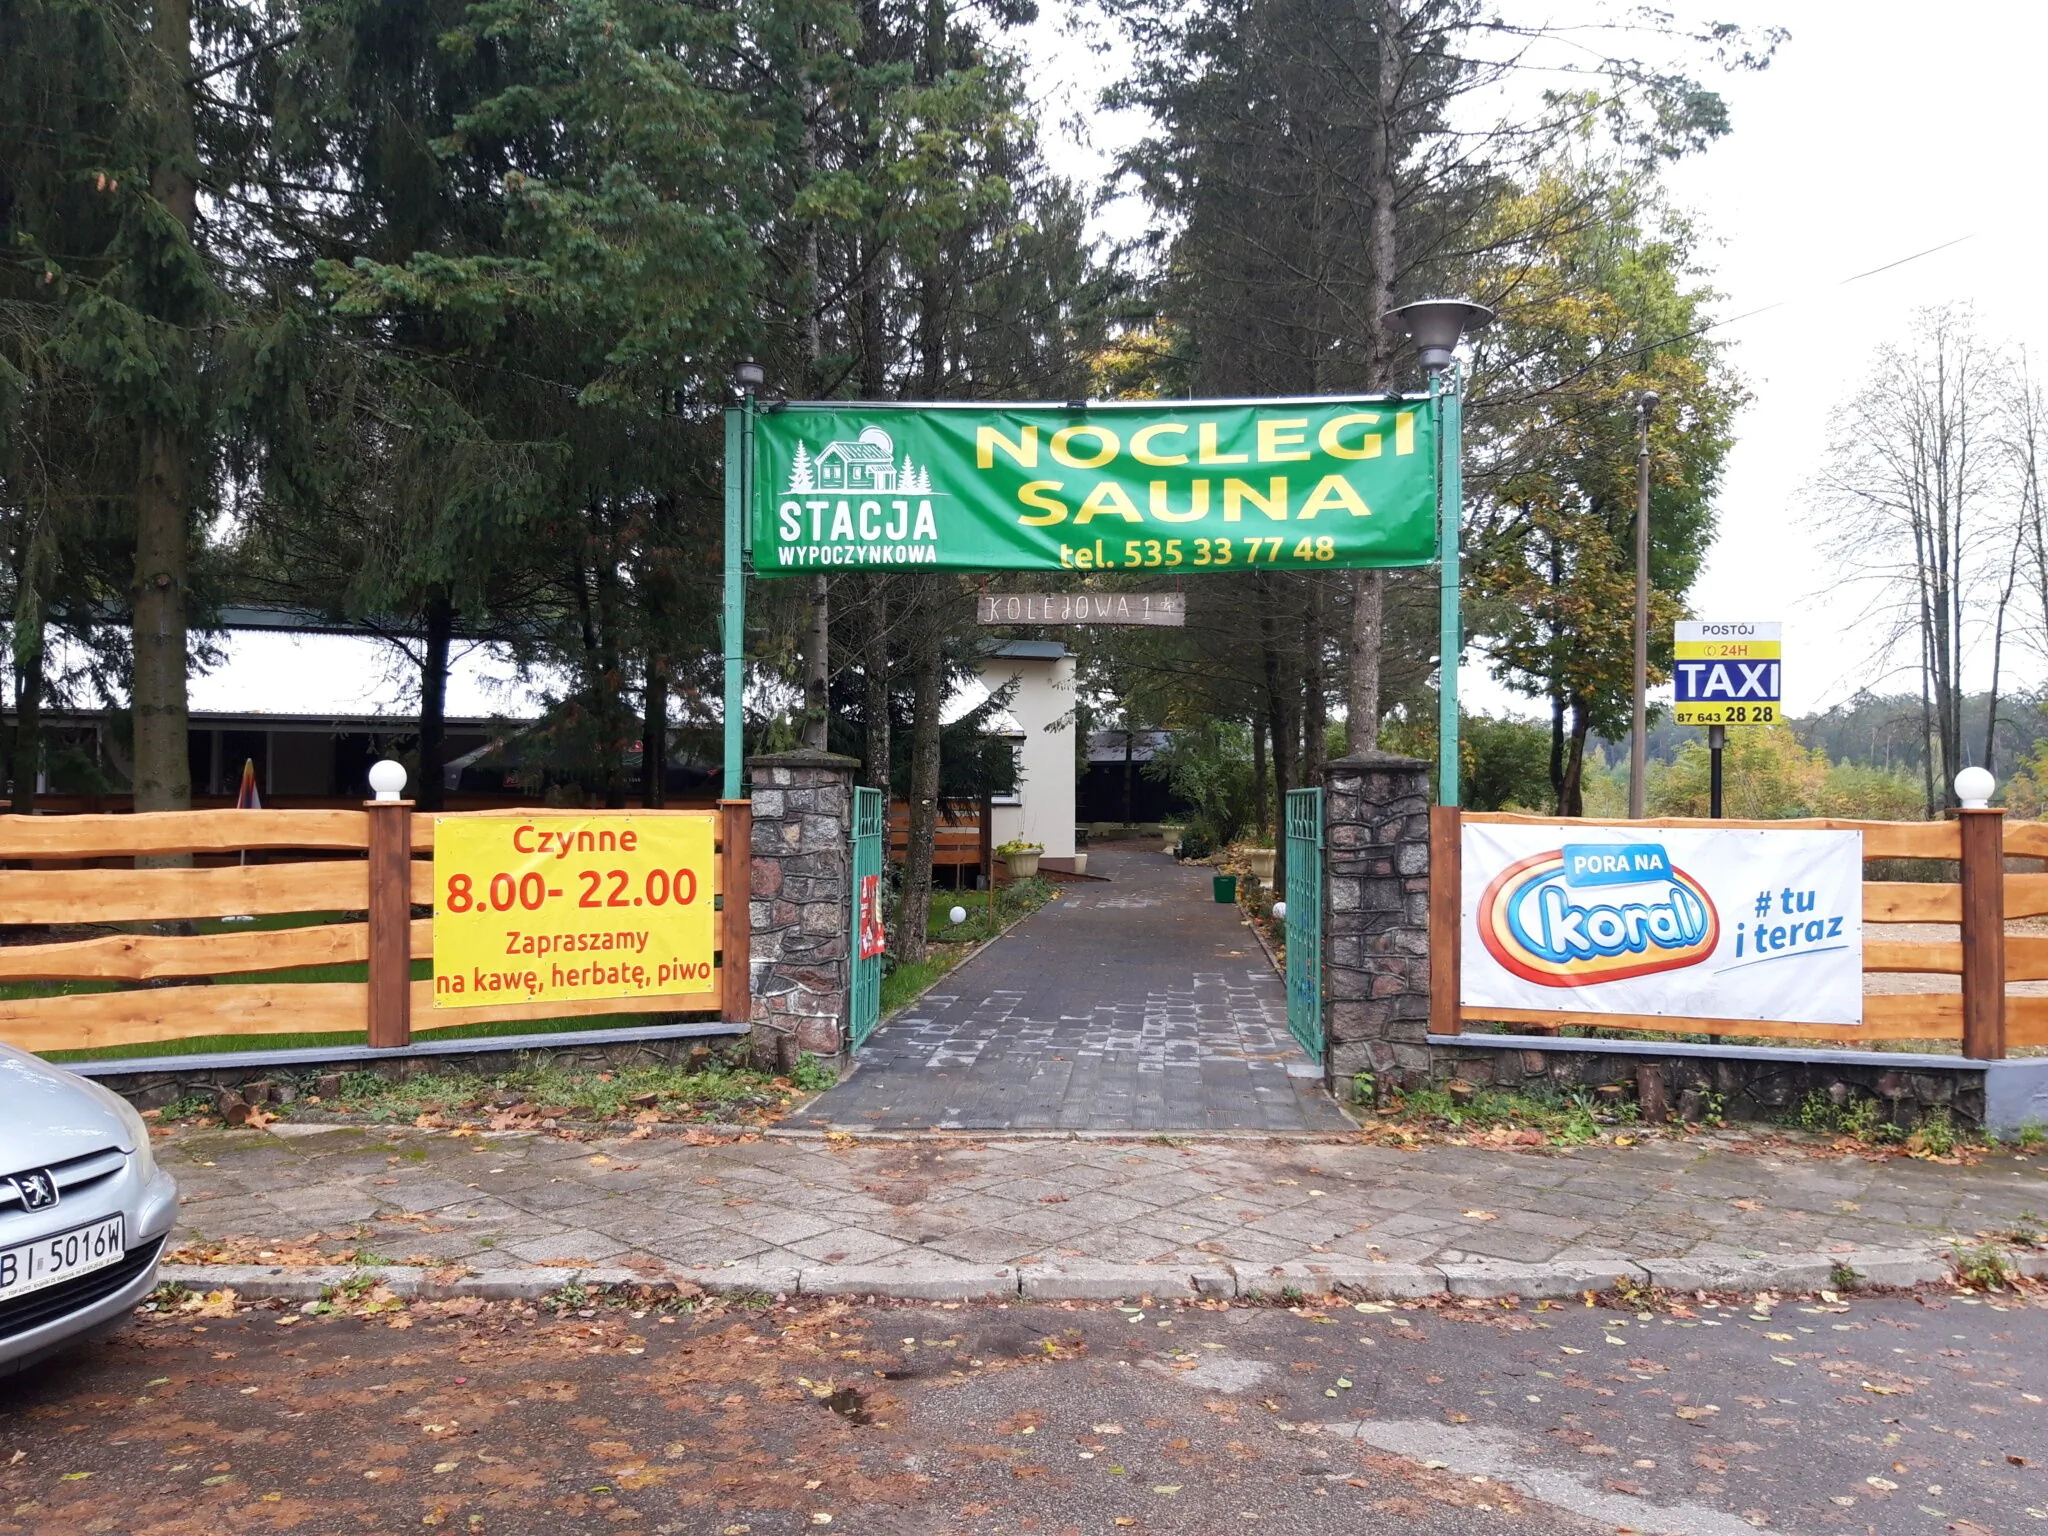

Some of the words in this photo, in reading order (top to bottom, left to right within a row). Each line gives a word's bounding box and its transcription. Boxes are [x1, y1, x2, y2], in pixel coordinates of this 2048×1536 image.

[976, 412, 1414, 470] NOCLEGI
[1017, 475, 1372, 526] SAUNA
[779, 500, 938, 542] STACJA
[778, 545, 938, 566] WYPOCZYNKOWA
[1060, 540, 1115, 569] tel.
[1124, 540, 1183, 566] 535
[1194, 540, 1233, 565] 33
[1246, 538, 1283, 563] 77
[1294, 536, 1335, 561] 48
[984, 596, 1130, 622] KOLEJOWA
[1702, 623, 1755, 635] POSTÓJ
[1720, 645, 1748, 656] 24H
[1678, 663, 1779, 698] TAXI
[1677, 713, 1693, 722] 87
[1697, 713, 1721, 722] 643
[1725, 707, 1746, 722] 28
[1752, 707, 1773, 722] 28
[513, 825, 637, 859] Czynne
[1574, 856, 1630, 874] PORA
[1635, 854, 1664, 871] NA
[446, 872, 564, 914] 8.00-
[578, 868, 697, 908] 22.00
[1539, 884, 1700, 961] koral
[1735, 923, 1745, 958] i
[1754, 914, 1844, 953] teraz
[505, 931, 649, 958] Zapraszamy
[436, 975, 465, 994] na
[473, 967, 544, 995] kawę,
[551, 962, 651, 989] herbatę,
[658, 956, 711, 985] piwo
[1, 1247, 33, 1289] BI
[51, 1220, 120, 1272] 5016W
